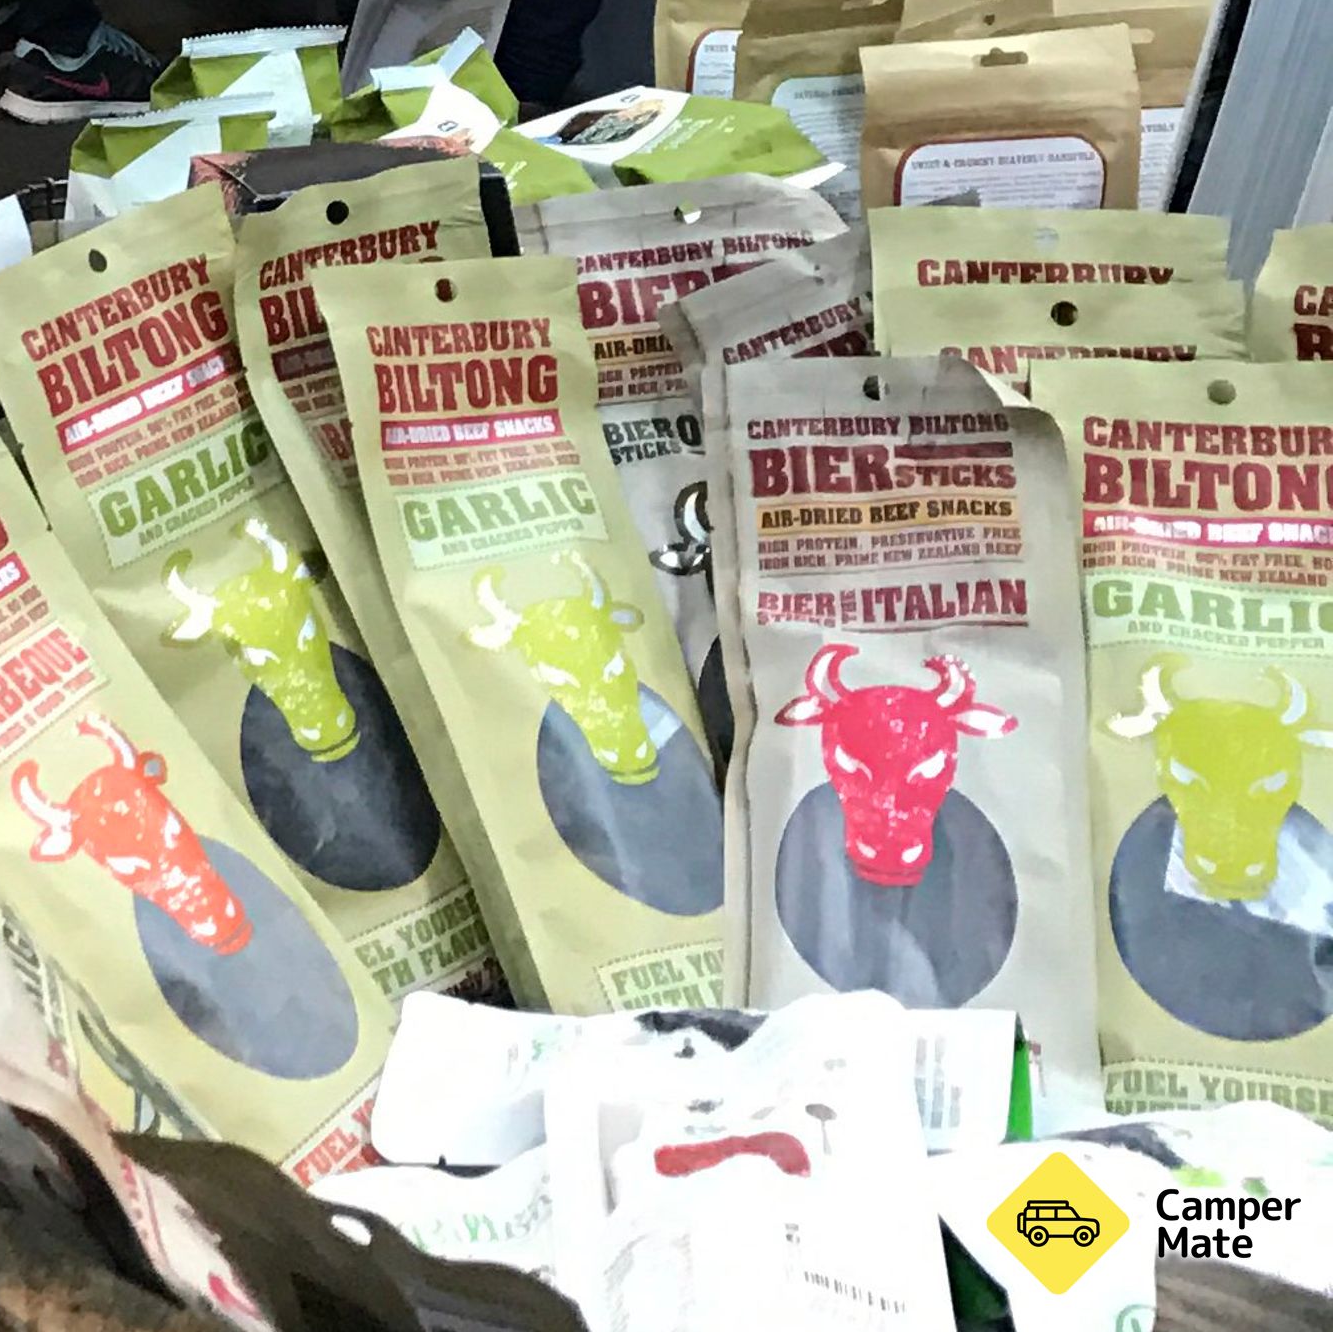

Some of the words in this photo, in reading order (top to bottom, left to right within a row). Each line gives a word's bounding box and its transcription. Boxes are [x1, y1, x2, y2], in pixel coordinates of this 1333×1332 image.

[21, 253, 212, 363] CANTERBURY
[722, 296, 864, 366] CANTERBURY
[37, 289, 229, 418] BILTONG
[365, 318, 552, 358] CANTERBURY
[373, 354, 559, 414] BILTONG
[603, 417, 678, 447] BIER
[747, 415, 901, 440] CANTERBURY
[908, 412, 1010, 437] BILTONG
[1083, 416, 1333, 457] CANTERBUR
[99, 420, 269, 538] GARLIC
[748, 443, 894, 498] BIER
[894, 463, 1017, 489] STICKS
[1083, 452, 1333, 512] BILTON
[402, 477, 597, 543] GARLIC
[761, 507, 863, 529] AIR-DRIED
[869, 501, 921, 524] BEEF
[926, 499, 1013, 519] SNACKS
[758, 592, 836, 617] BIER
[860, 579, 1028, 624] ITALIAN
[610, 960, 685, 997] FUEL
[1105, 1069, 1189, 1099] FUEL
[292, 1125, 362, 1190] FUEL
